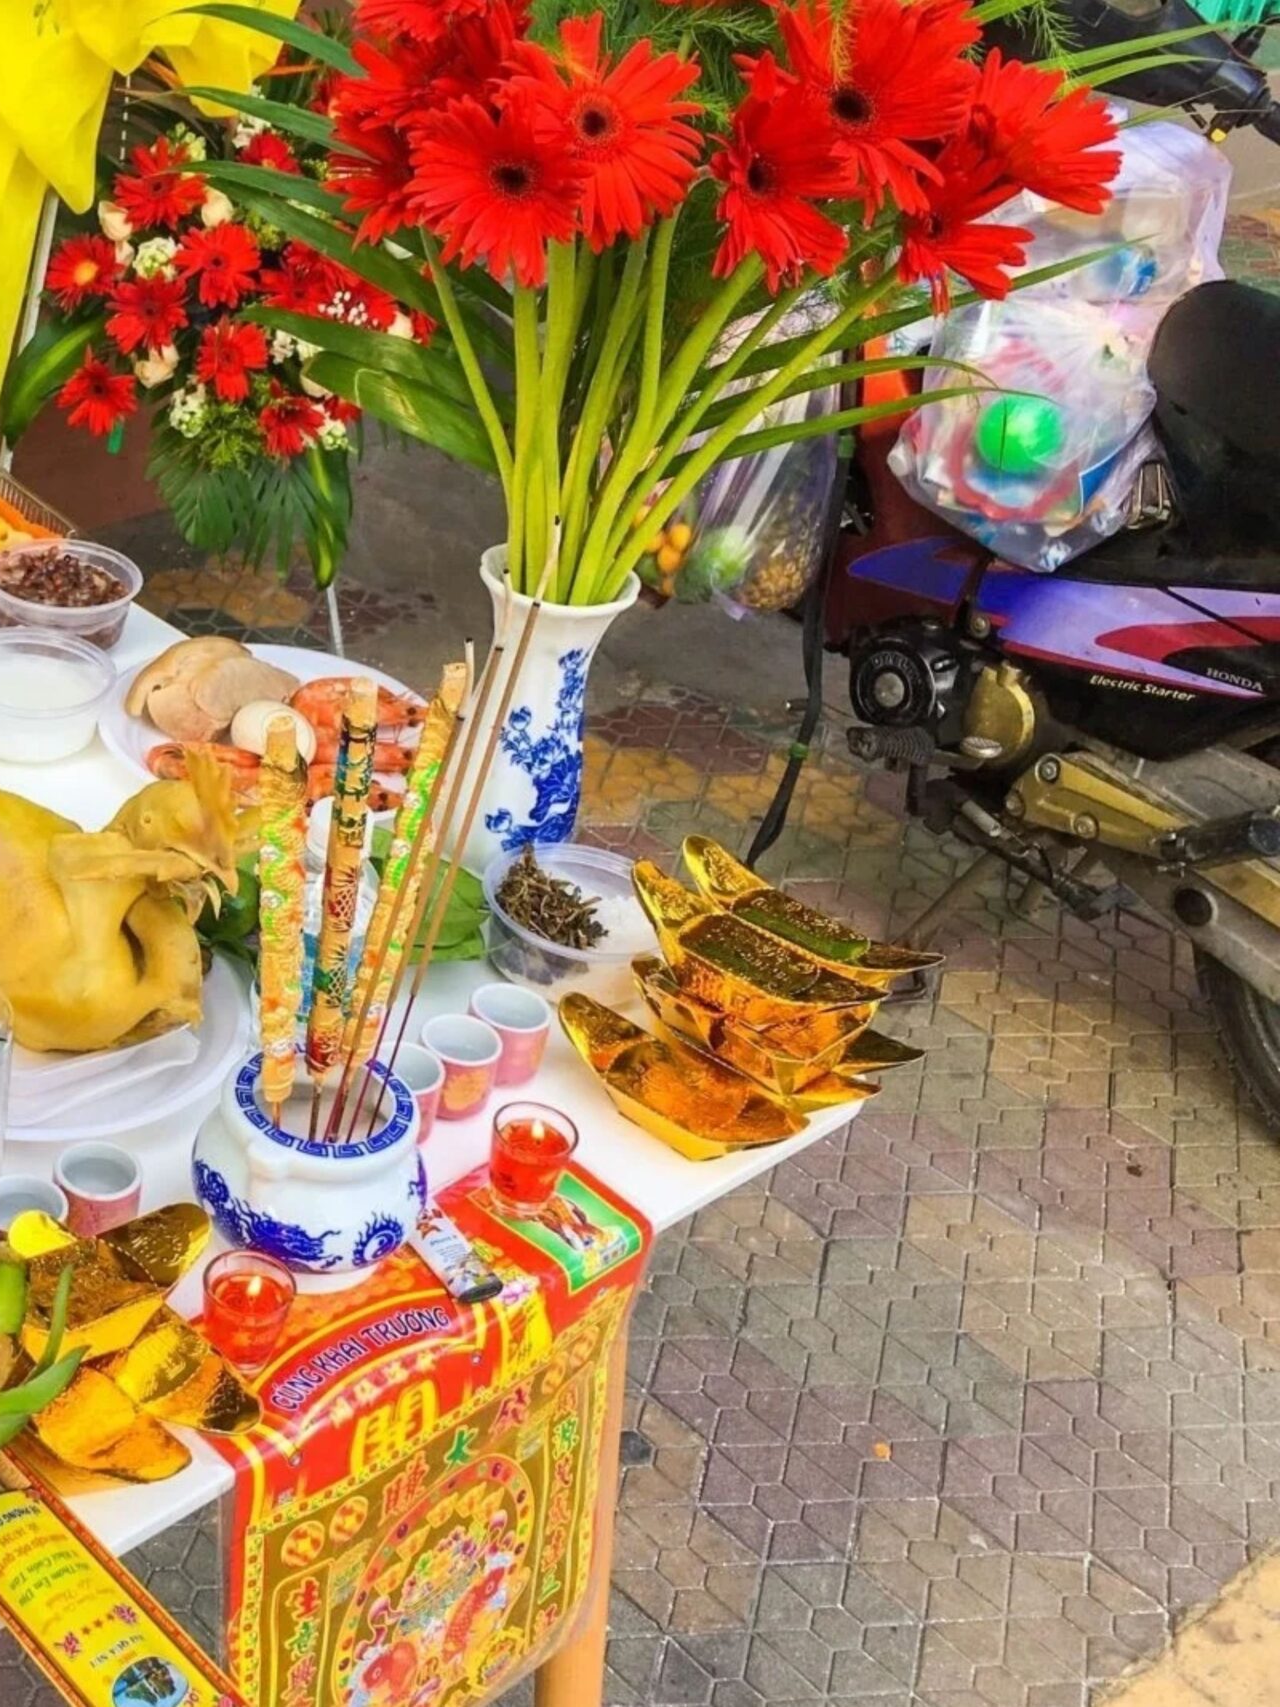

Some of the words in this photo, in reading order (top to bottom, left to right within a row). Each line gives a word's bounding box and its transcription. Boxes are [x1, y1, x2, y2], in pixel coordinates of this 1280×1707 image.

[1089, 674, 1141, 692] Electric
[1142, 683, 1196, 701] Starter
[1206, 667, 1263, 691] HONDA
[311, 1337, 369, 1375] KHAI
[360, 1307, 450, 1347] TRƯƠNG
